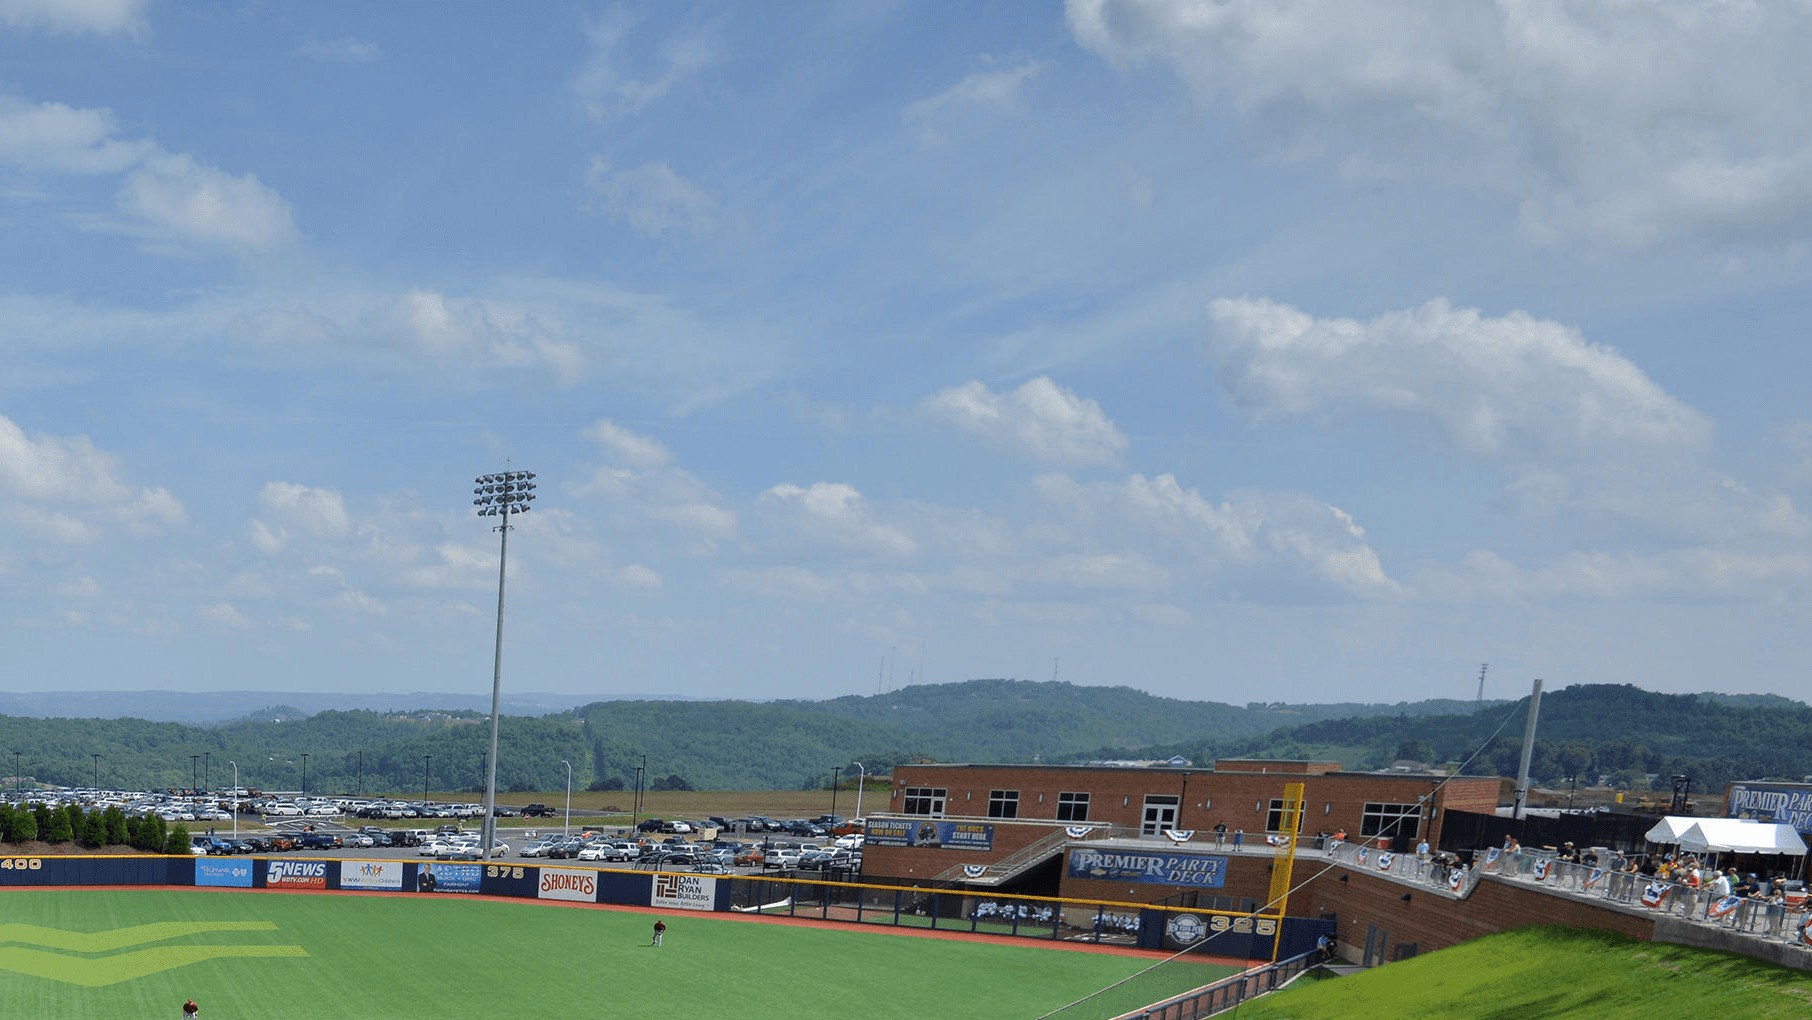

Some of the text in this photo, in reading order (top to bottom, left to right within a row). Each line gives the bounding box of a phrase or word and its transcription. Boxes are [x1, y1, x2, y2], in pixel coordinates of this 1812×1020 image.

[1729, 789, 1788, 820] PREMIER
[1, 859, 41, 869] 400
[1077, 853, 1164, 876] PREMIER
[1166, 858, 1222, 872] PARTY
[267, 862, 325, 883] 5 NEWS
[436, 865, 481, 877] ASTRO
[487, 865, 524, 879] 375
[1167, 870, 1215, 883] DECK
[541, 874, 594, 894] SHONEY'S
[679, 876, 699, 885] DAN
[678, 885, 702, 894] RYAN
[678, 893, 709, 902] BUILDERS
[1210, 916, 1276, 935] 325
